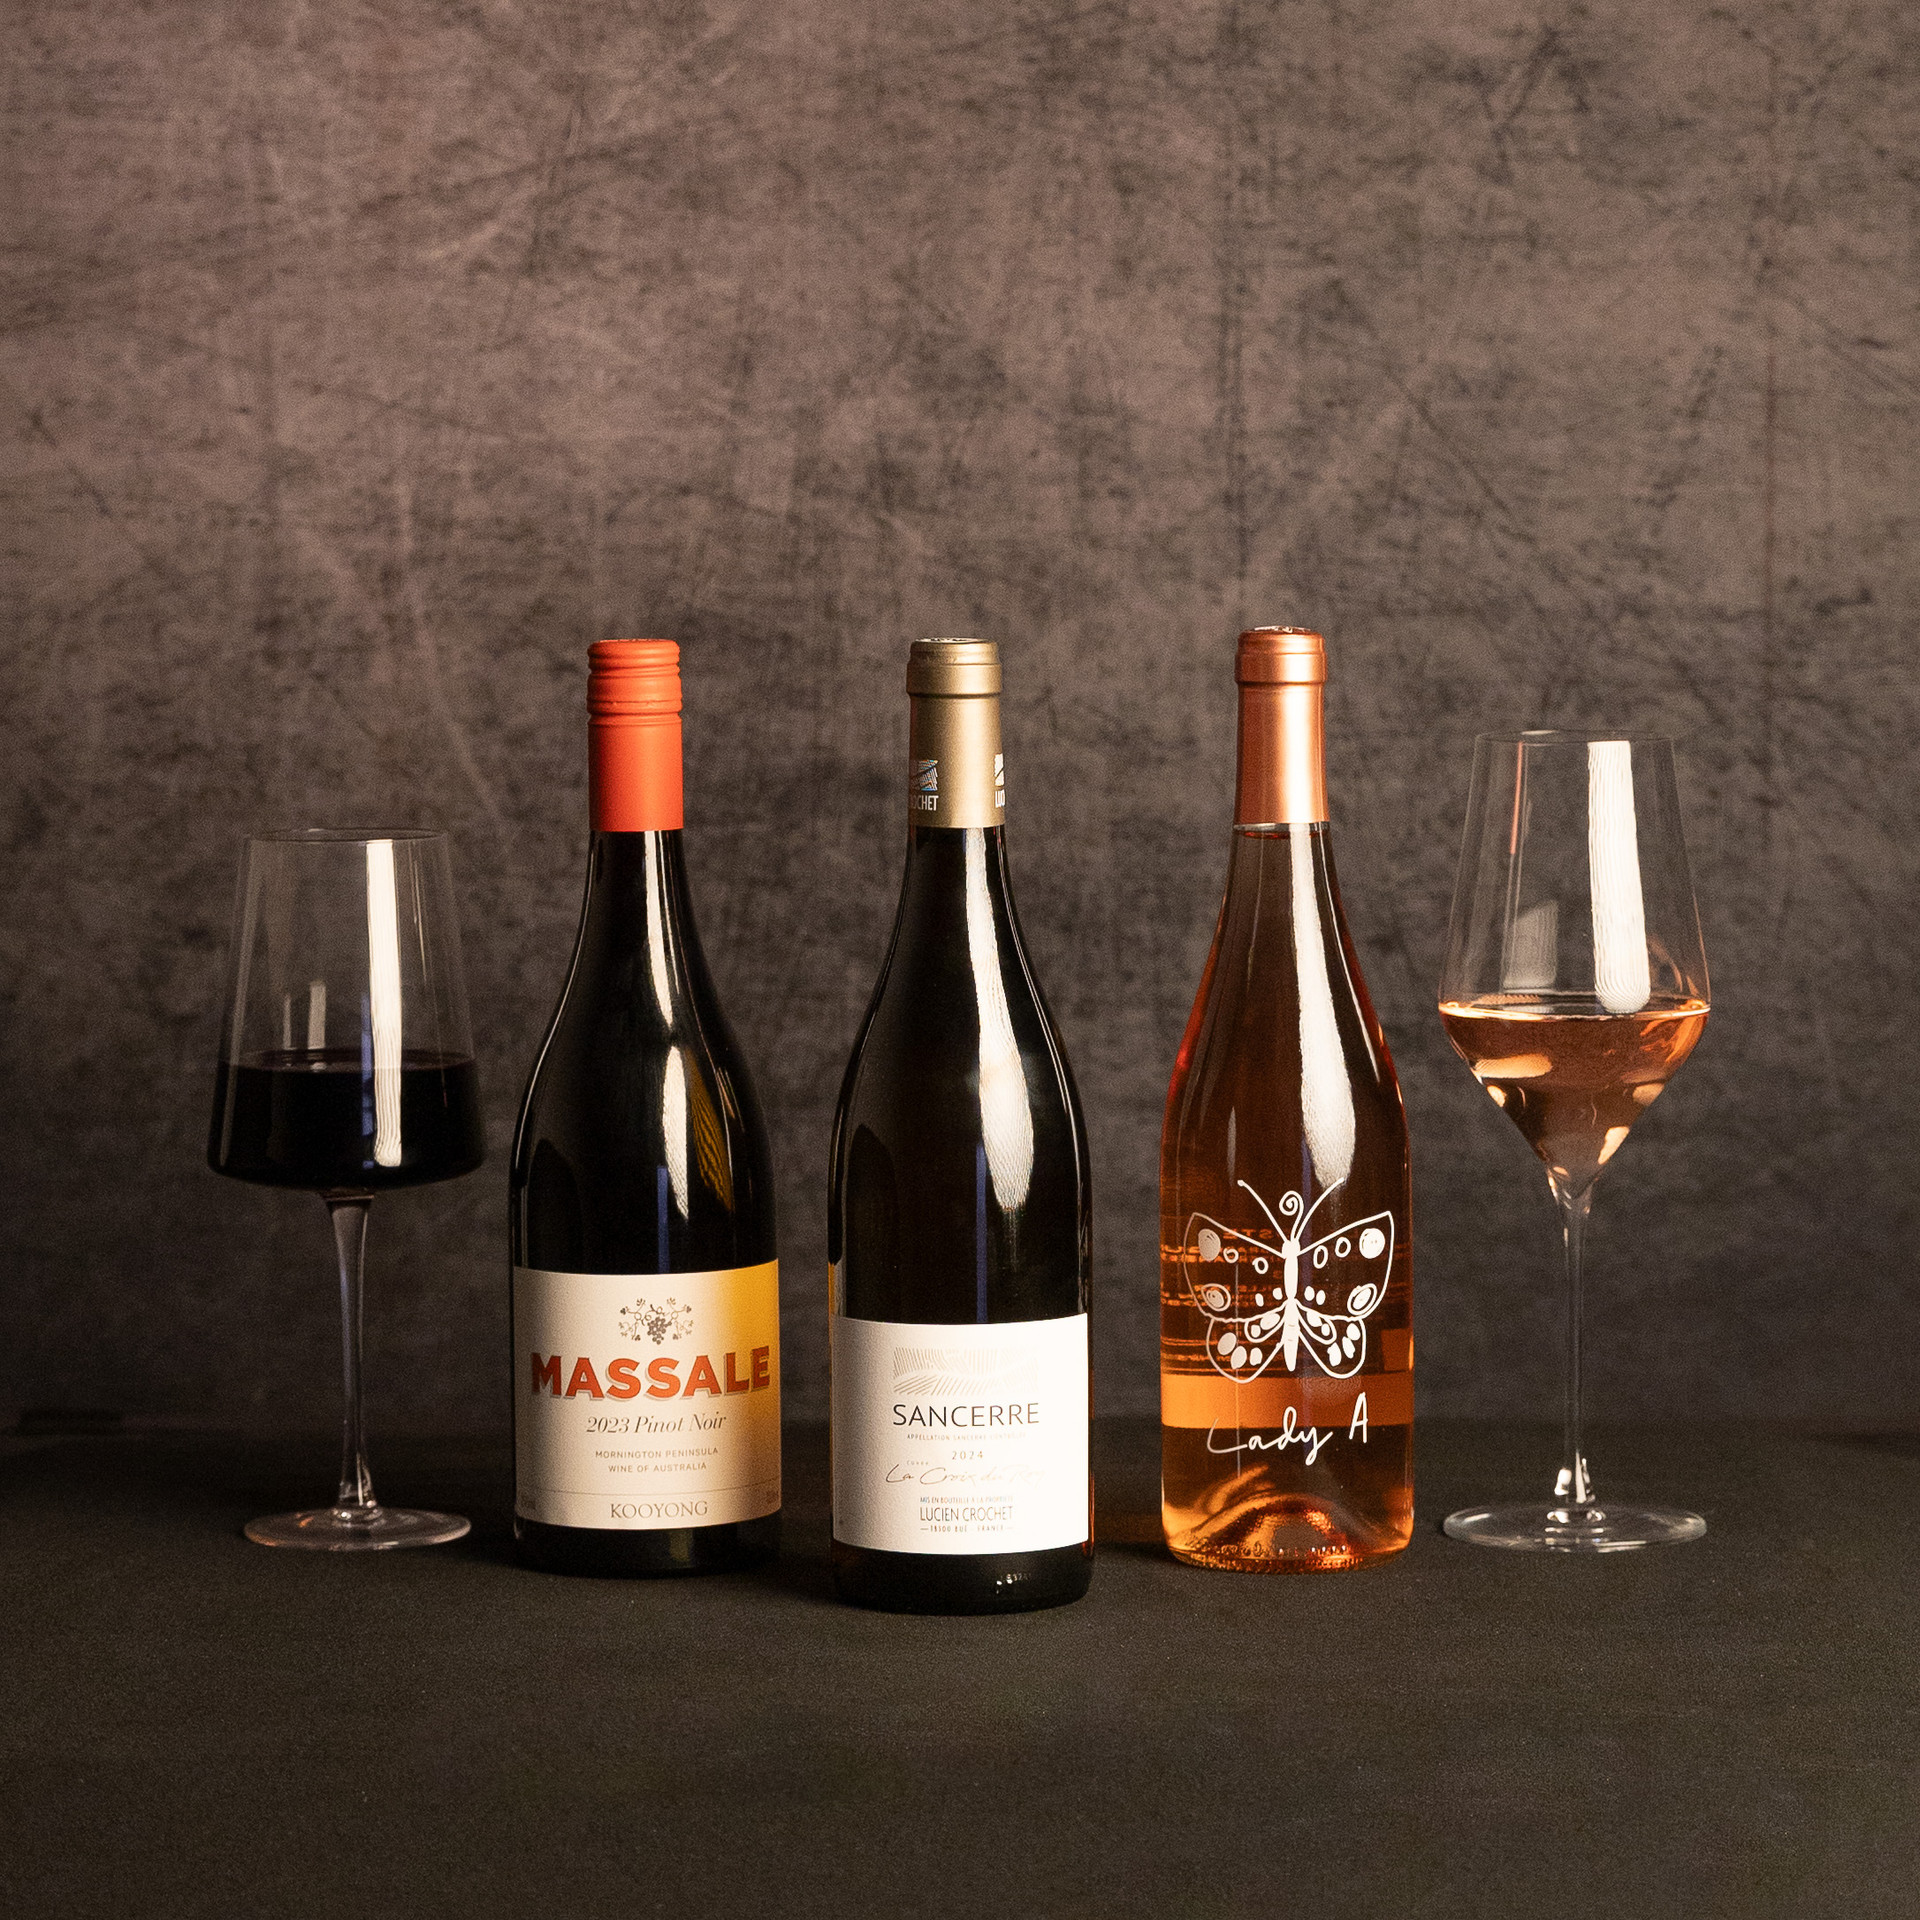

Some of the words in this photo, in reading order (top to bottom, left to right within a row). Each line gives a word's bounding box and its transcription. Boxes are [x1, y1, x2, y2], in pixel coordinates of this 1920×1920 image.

[531, 1345, 770, 1401] MASSALE
[586, 1416, 630, 1433] 2023
[633, 1415, 683, 1433] Pinot
[689, 1410, 727, 1432] Noir
[892, 1402, 1040, 1428] SANCERRE
[1206, 1405, 1334, 1466] Lady
[1348, 1391, 1369, 1444] A
[594, 1450, 662, 1460] MORNINGTON
[665, 1446, 719, 1458] PENINSULA
[951, 1450, 984, 1461] 2024
[608, 1463, 633, 1473] WINE
[636, 1463, 650, 1473] OF
[653, 1461, 707, 1473] AUSTRALIA
[610, 1500, 708, 1519] KOOYONG
[920, 1507, 960, 1522] LUCIEN
[962, 1505, 1014, 1521] CROCHET
